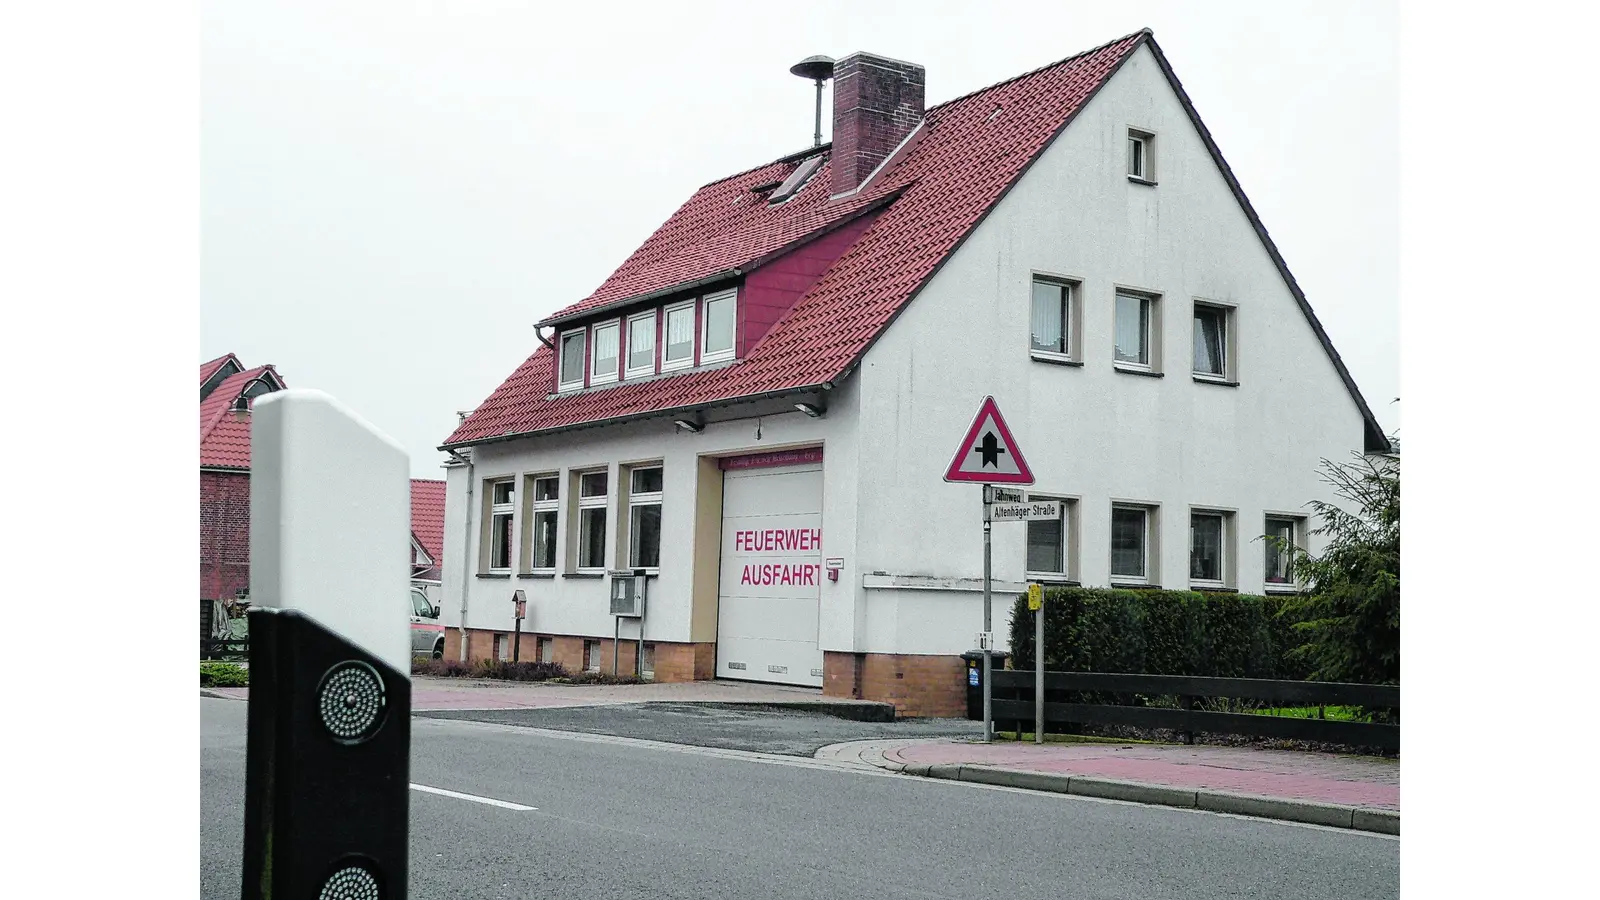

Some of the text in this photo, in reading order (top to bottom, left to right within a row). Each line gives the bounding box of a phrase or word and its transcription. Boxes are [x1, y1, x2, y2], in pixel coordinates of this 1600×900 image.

[995, 490, 1020, 502] Jahnweg
[995, 504, 1055, 519] Altenhäger Straße
[736, 529, 820, 551] FEUERWEH
[741, 564, 820, 586] AUSFAHRT
